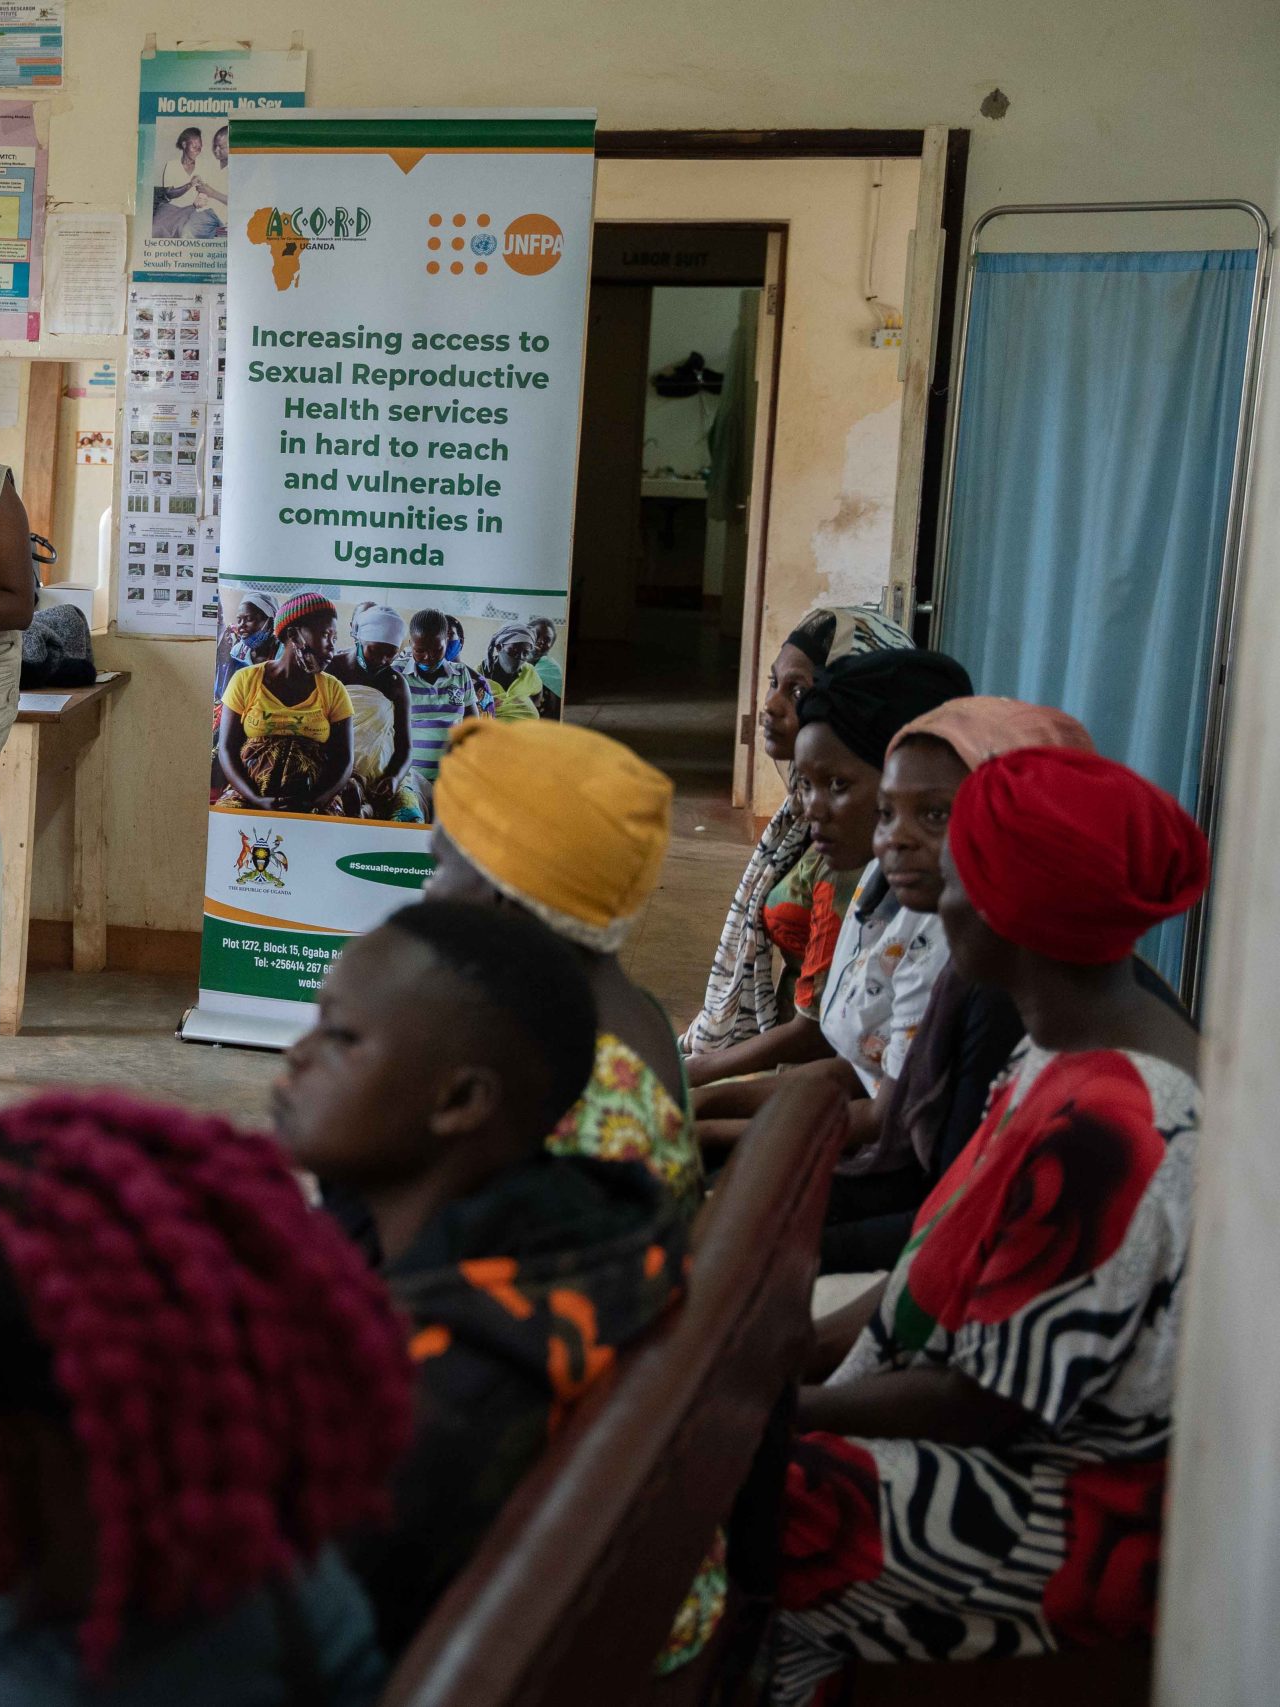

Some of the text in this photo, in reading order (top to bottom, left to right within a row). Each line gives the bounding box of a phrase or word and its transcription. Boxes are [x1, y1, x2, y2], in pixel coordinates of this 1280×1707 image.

[158, 97, 175, 112] No
[238, 97, 256, 108] No
[258, 97, 282, 108] Sex
[155, 251, 182, 259] protect
[502, 234, 565, 256] UNFPA
[144, 260, 171, 268] Sexually
[623, 252, 669, 266] LABOR
[252, 325, 549, 355] Increasing access to
[248, 361, 549, 391] Sexual Reproductive
[284, 397, 508, 425] Health services
[280, 430, 508, 461] in hard to reach
[284, 468, 501, 497] and vulnerable
[278, 505, 503, 533] communities in
[334, 541, 444, 568] Uganda
[223, 938, 239, 950] Plot
[242, 940, 261, 953] 1272,
[263, 941, 287, 953] Block
[289, 944, 300, 956] 15,
[302, 946, 329, 959] Ggaba
[254, 957, 336, 974] Tel: +256414 267 66
